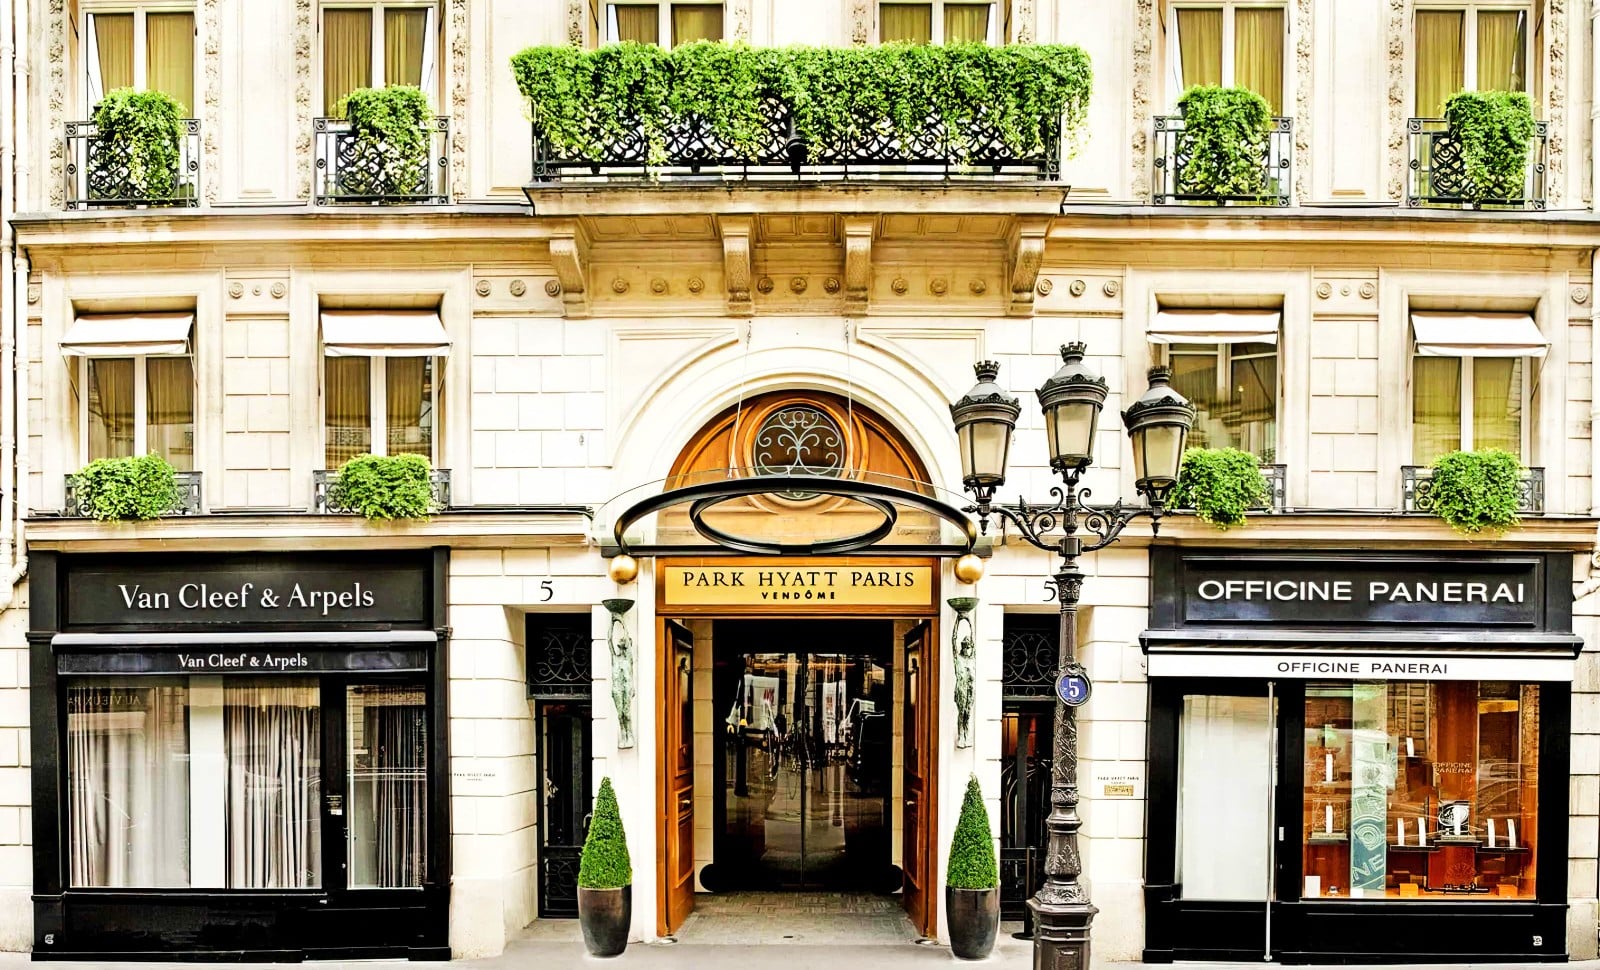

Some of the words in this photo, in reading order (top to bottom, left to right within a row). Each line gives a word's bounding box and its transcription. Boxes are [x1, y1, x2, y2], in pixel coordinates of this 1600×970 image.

[684, 572, 744, 586] PARK
[759, 572, 837, 586] HYATT
[852, 572, 913, 586] PARIS
[118, 585, 169, 608] Van
[179, 583, 253, 608] Cleef
[261, 589, 279, 607] &
[288, 583, 374, 615] Arpels
[541, 581, 553, 601] 5
[761, 589, 835, 599] VENDÔME
[1043, 581, 1058, 601] 5
[1198, 581, 1352, 600] OFFICINE
[1369, 582, 1524, 602] PANERAI
[178, 655, 204, 667] Van
[209, 654, 246, 666] Cleef
[250, 657, 259, 666] &
[264, 653, 307, 670] Arpels
[1278, 663, 1359, 672] OFFICINE
[1372, 664, 1446, 673] PANERAI
[1068, 678, 1080, 698] 5
